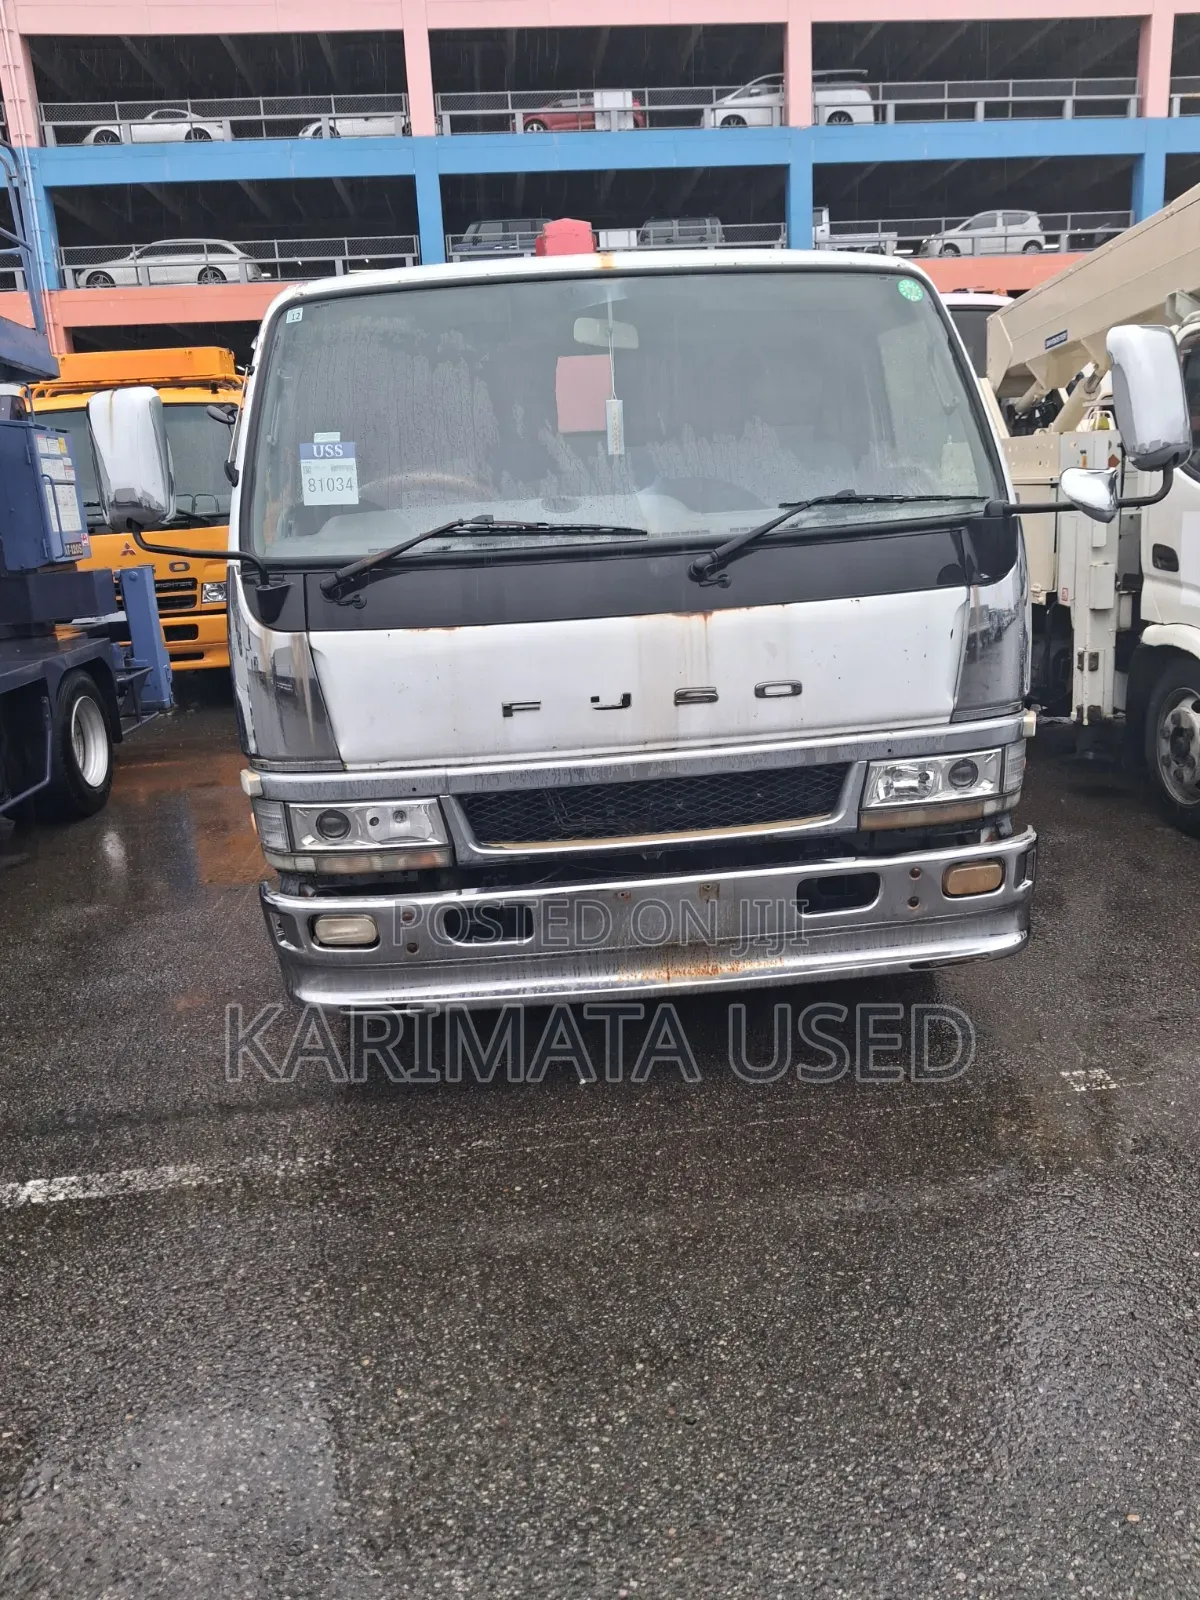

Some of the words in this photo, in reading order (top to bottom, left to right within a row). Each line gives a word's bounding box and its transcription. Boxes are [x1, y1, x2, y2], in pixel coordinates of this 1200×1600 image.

[291, 312, 301, 320] 12
[312, 444, 343, 458] USS
[308, 477, 353, 493] 81034
[501, 679, 802, 717] FUSO
